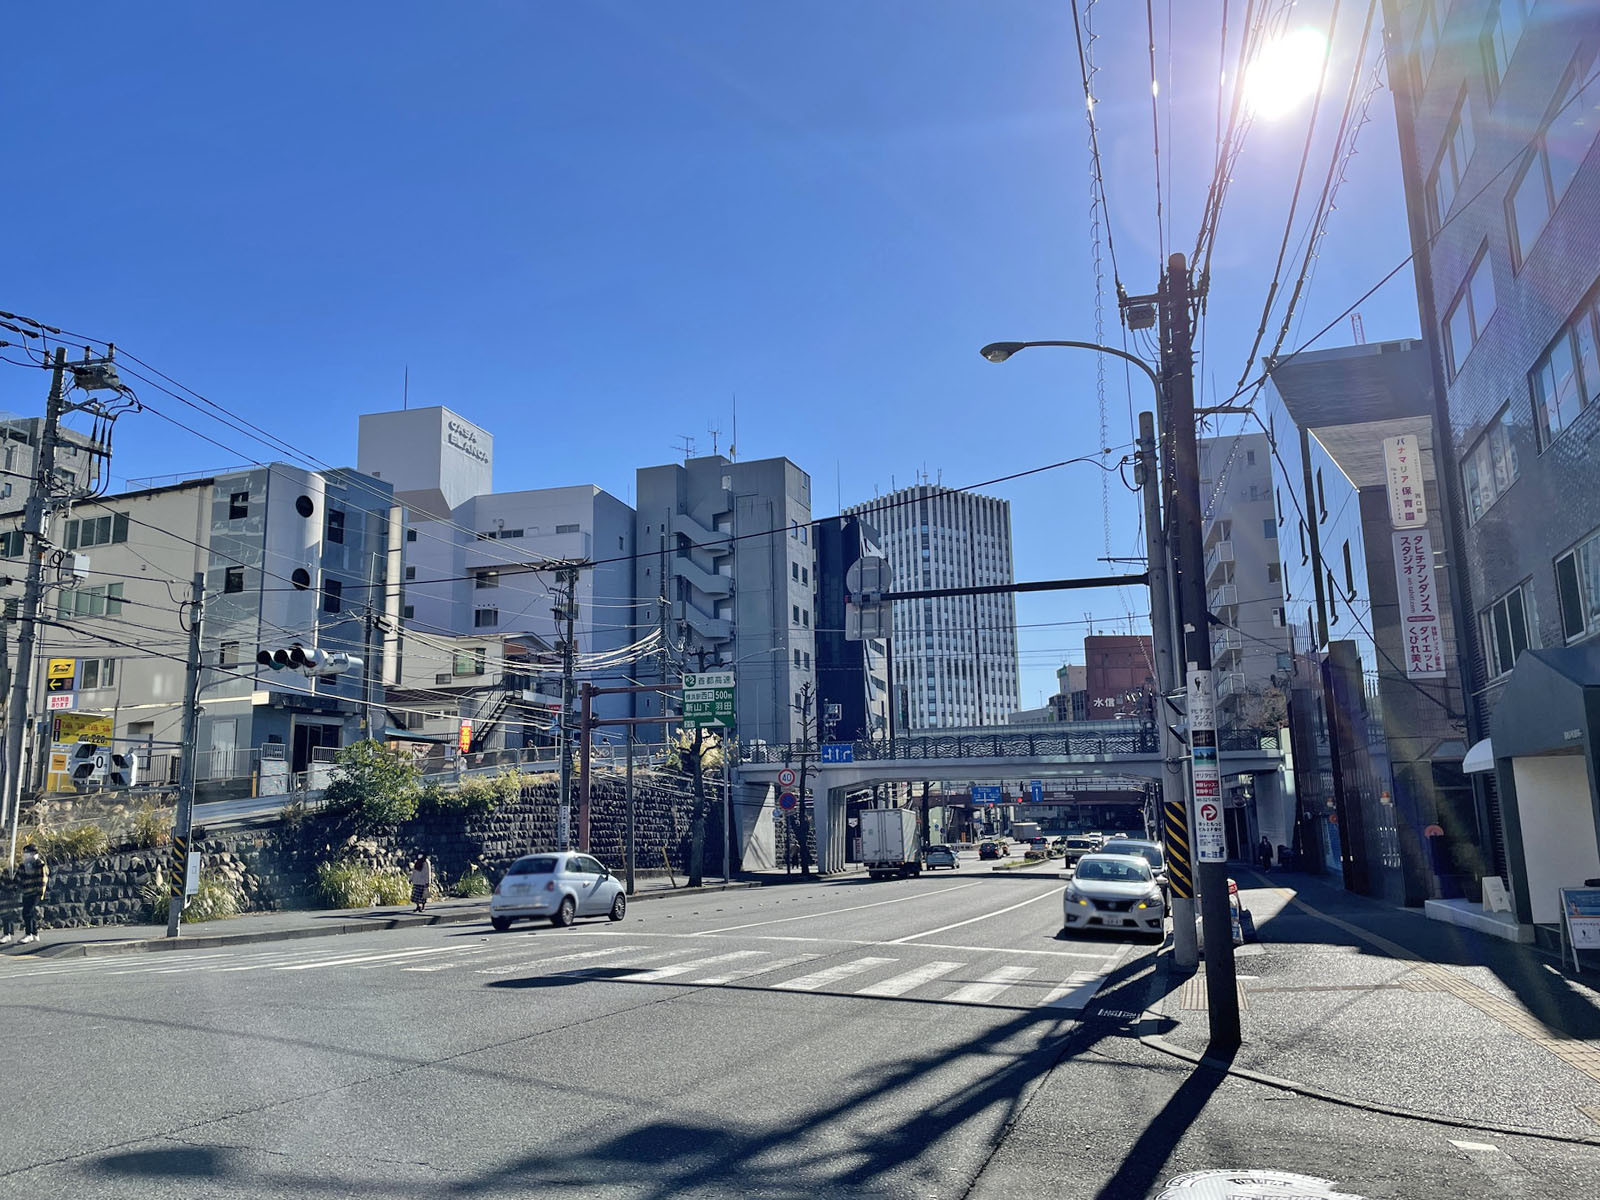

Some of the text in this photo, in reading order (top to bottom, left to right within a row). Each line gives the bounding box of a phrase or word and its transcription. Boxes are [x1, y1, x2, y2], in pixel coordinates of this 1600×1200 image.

[1400, 536, 1414, 575] スタジオ
[1413, 535, 1432, 613] タヒチアンダンス
[1408, 626, 1422, 672] くびれ美人
[1419, 625, 1434, 672] ダイエット
[698, 676, 731, 685] 首都高速
[685, 701, 732, 711] 新山下 羽田
[715, 690, 732, 700] 500m
[782, 772, 792, 782] 40
